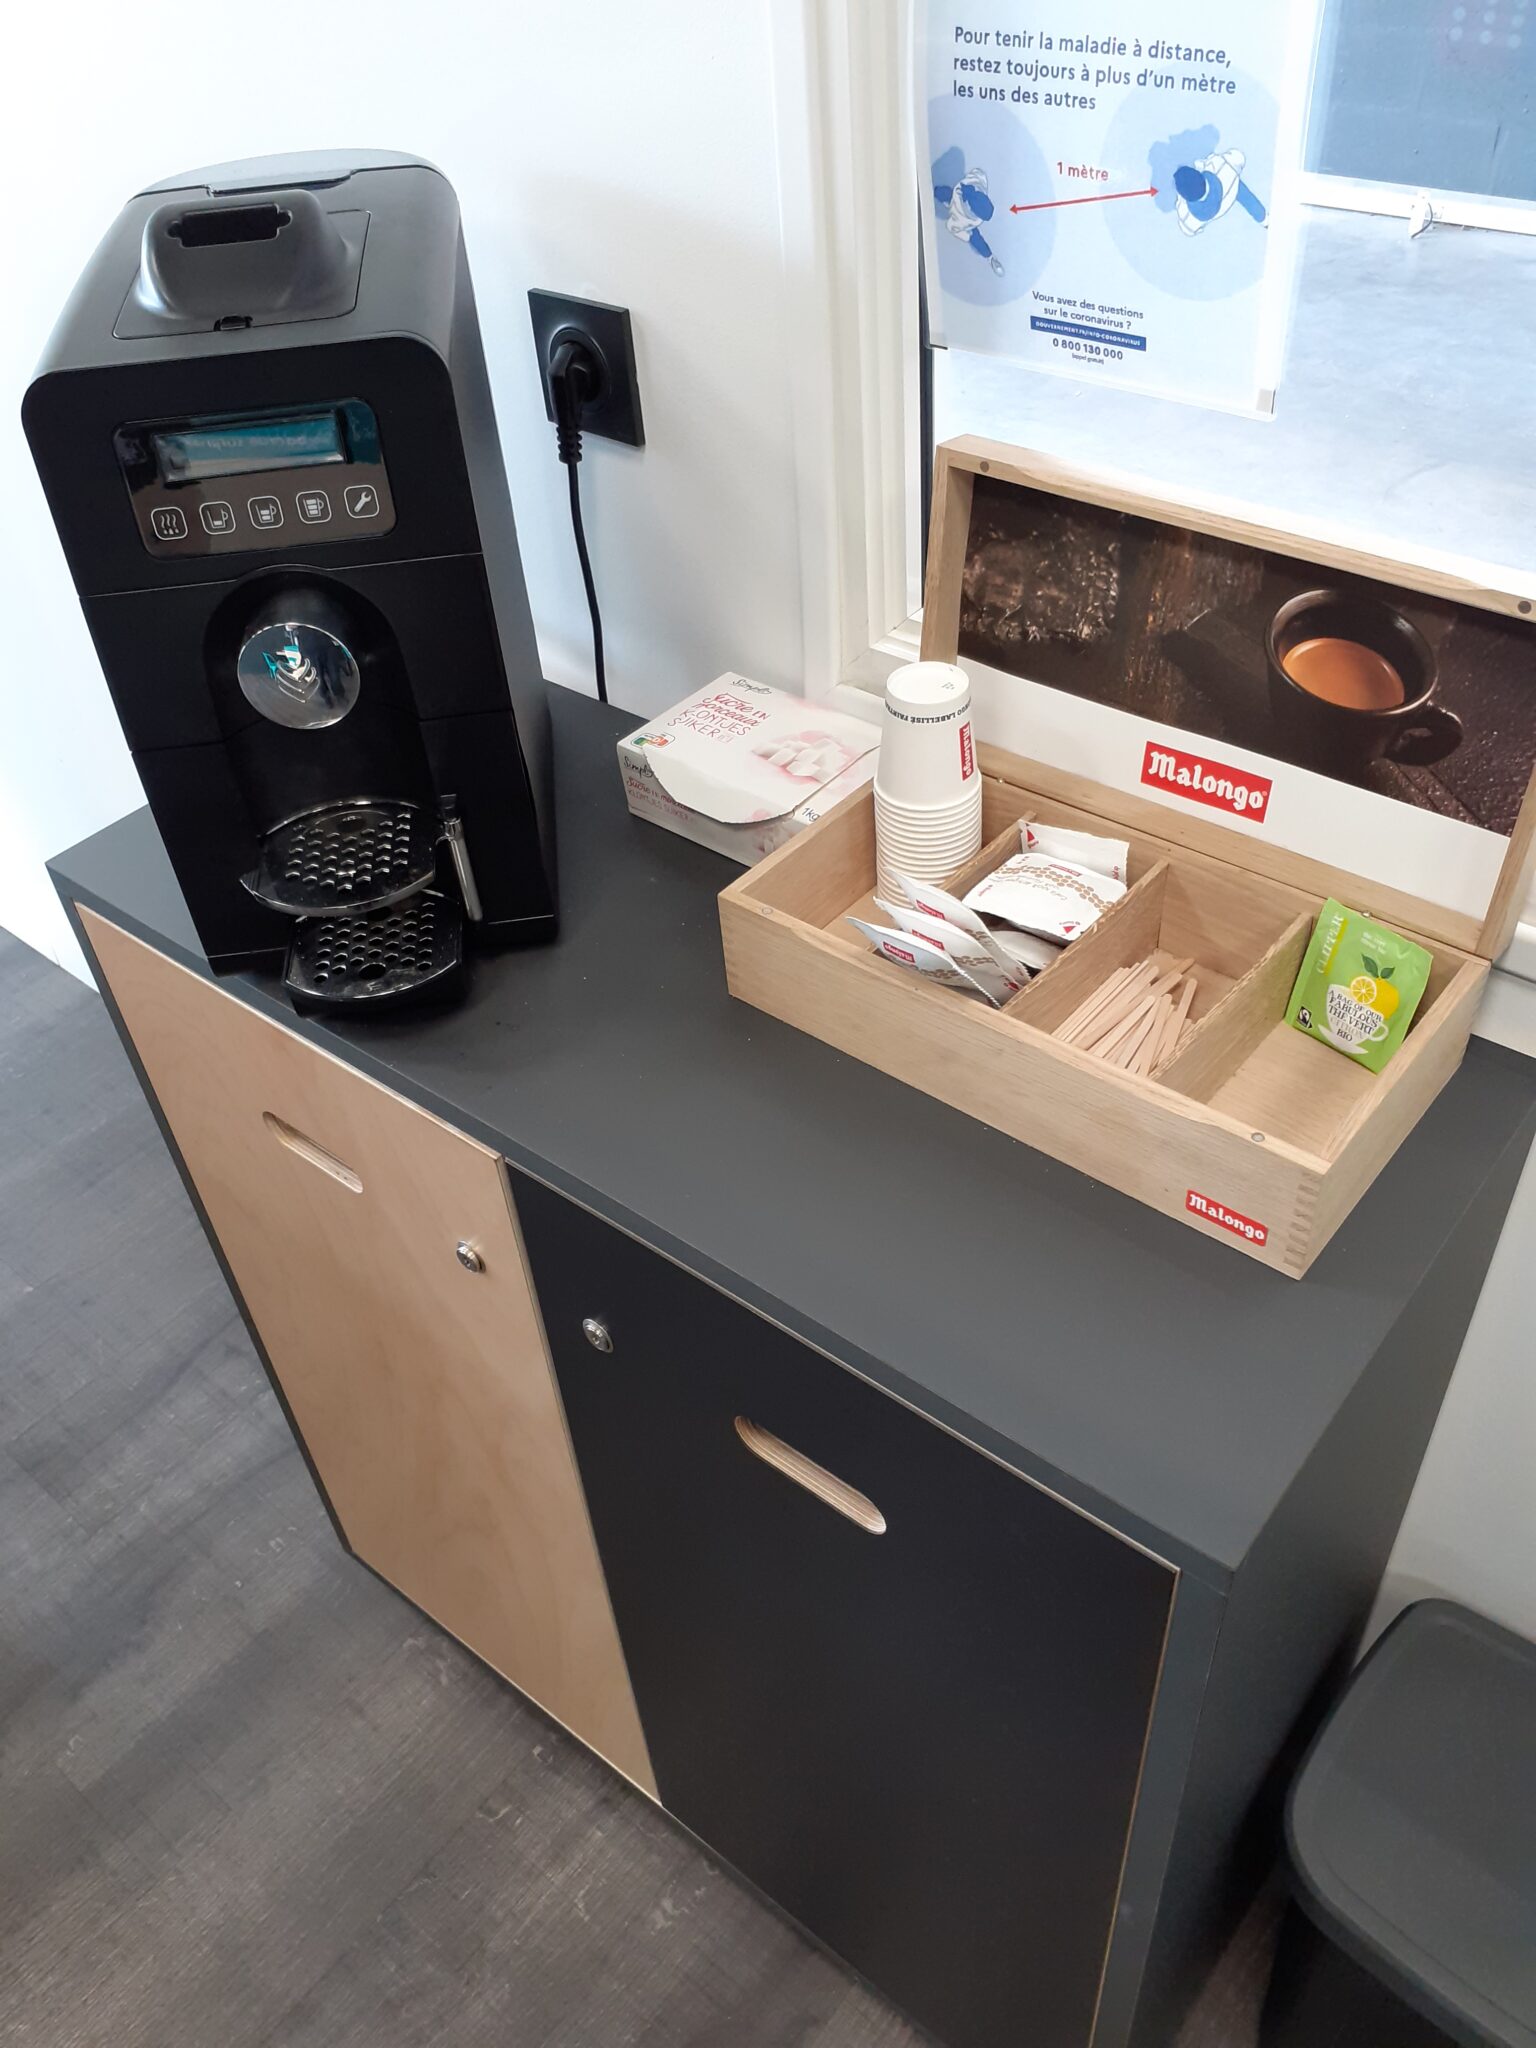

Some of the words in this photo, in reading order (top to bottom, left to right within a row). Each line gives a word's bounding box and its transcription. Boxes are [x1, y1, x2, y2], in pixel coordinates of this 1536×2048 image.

[955, 26, 990, 46] Pour
[995, 29, 1034, 49] tenir
[1039, 30, 1053, 51] la
[1059, 35, 1126, 56] maladie
[1133, 38, 1142, 58] à
[1148, 41, 1232, 68] distance,
[954, 55, 1001, 74] restez
[1006, 59, 1075, 83] toujours
[1081, 63, 1090, 82] à
[1095, 66, 1130, 88] plus
[1181, 73, 1236, 95] mètre
[953, 80, 974, 99] les
[979, 87, 1006, 102] uns
[1011, 85, 1039, 105] des
[1044, 91, 1096, 111] autres
[1056, 161, 1063, 175] 1
[1067, 162, 1109, 181] mètre
[1032, 290, 1054, 303] Vous
[1057, 297, 1077, 307] avez
[1080, 299, 1095, 311] des
[1098, 305, 1144, 319] questions
[1044, 307, 1058, 316] sur
[1059, 307, 1068, 318] le
[1070, 312, 1124, 329] coronavirus
[1126, 320, 1132, 330] ?
[1052, 338, 1059, 347] 0
[1061, 339, 1081, 352] 800
[1084, 343, 1101, 356] 130
[1103, 347, 1123, 360] 000
[702, 692, 754, 713] Sucre
[910, 712, 956, 725] LABELLISÉ
[962, 724, 971, 776] Malongo
[1148, 751, 1264, 811] Malongo
[1329, 997, 1378, 1028] FABULOUS
[1336, 993, 1353, 1006] BAG
[1354, 1003, 1364, 1012] OF
[1366, 1009, 1383, 1022] OUR
[1337, 1028, 1353, 1042] BIO
[1349, 1015, 1374, 1035] VERT
[1188, 1193, 1265, 1240] Malongo
